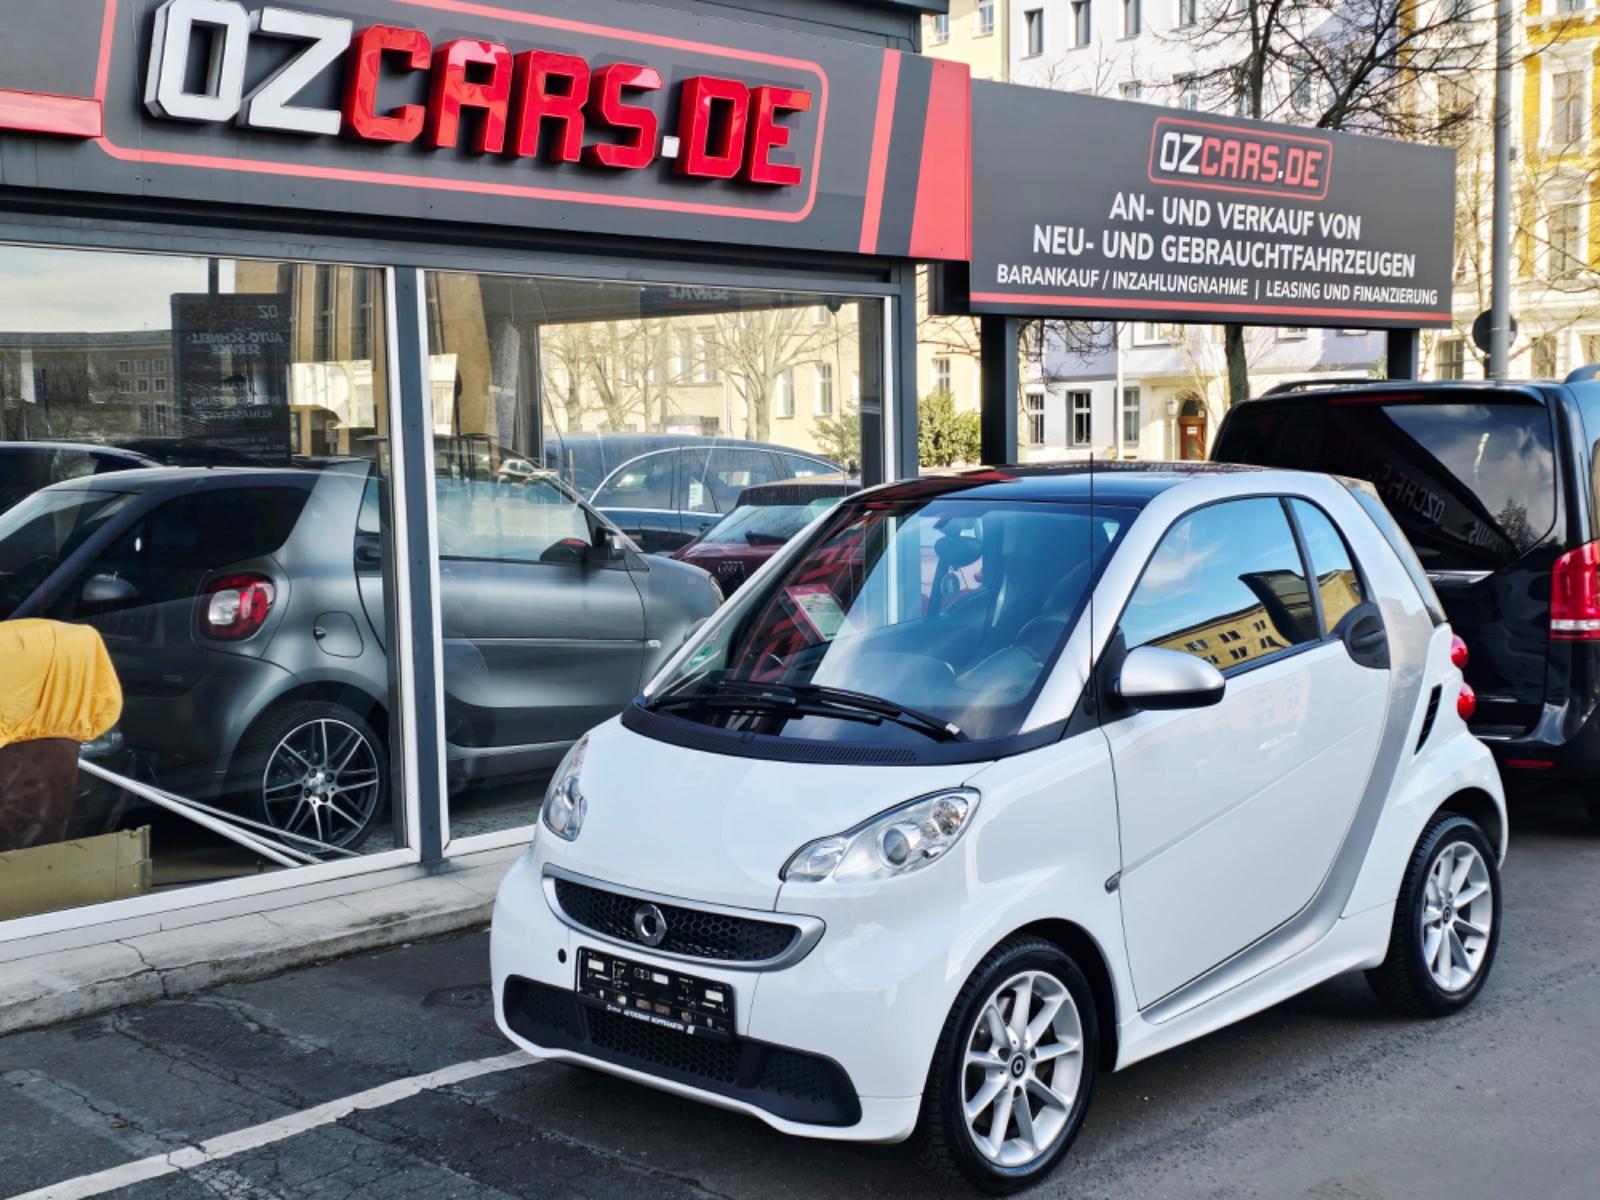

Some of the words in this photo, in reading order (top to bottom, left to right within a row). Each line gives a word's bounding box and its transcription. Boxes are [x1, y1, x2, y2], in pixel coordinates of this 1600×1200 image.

[144, 0, 812, 187] OZCARS.DE
[1159, 131, 1323, 188] OZCARS.DE
[1109, 192, 1154, 221] AN-
[1162, 196, 1211, 227] UND
[1217, 202, 1314, 236] VERKAUF
[1319, 212, 1361, 241] VON
[1033, 224, 1094, 255] NEU-
[1102, 230, 1154, 260] UND
[1161, 235, 1416, 278] GEBRAUCHTFAHRZEUGEN
[997, 264, 1099, 288] BARANKAUF
[1112, 271, 1248, 296] INZAHLUNGNAHME
[1266, 280, 1320, 299] LEASING
[1324, 284, 1350, 300] UND
[1353, 286, 1438, 305] FINANZIERUNG
